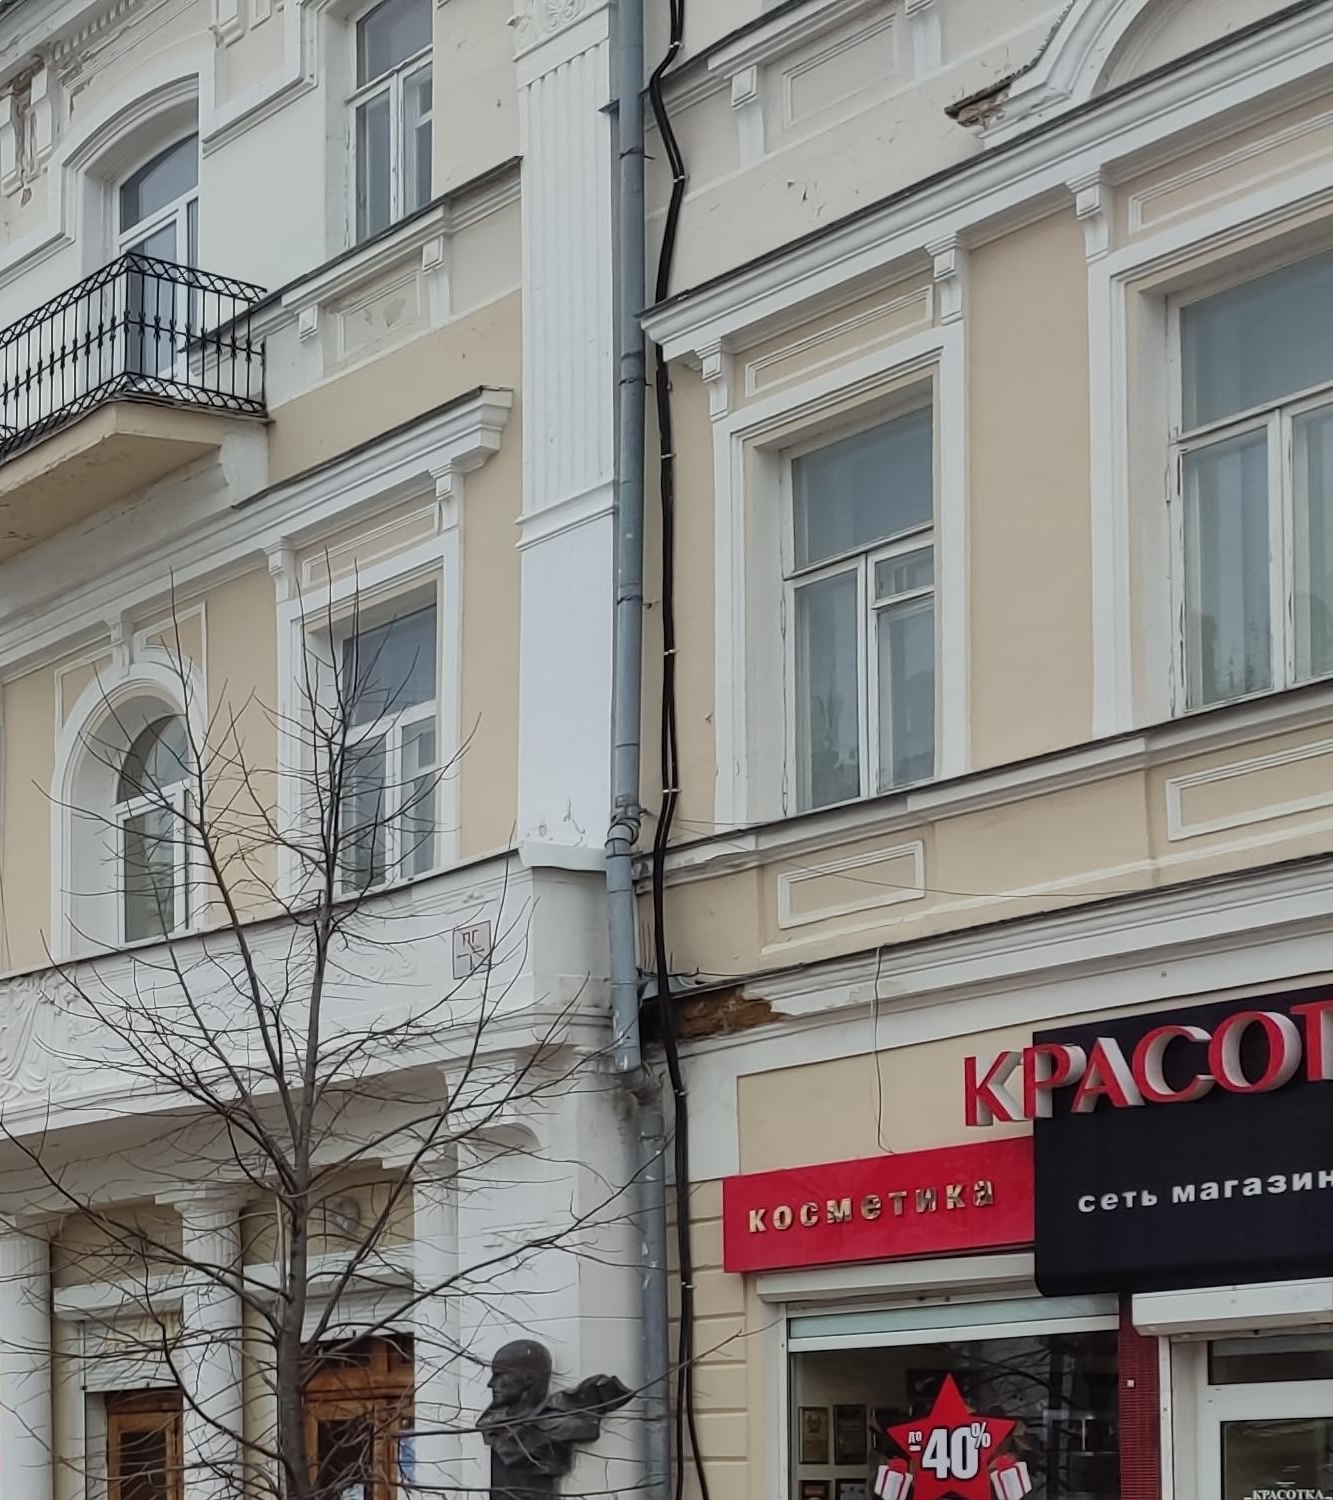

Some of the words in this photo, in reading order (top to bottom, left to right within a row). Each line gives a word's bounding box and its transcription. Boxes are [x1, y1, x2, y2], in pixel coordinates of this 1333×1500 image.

[748, 1180, 994, 1233] косметика
[1078, 1190, 1158, 1213] сеть
[1252, 1489, 1324, 1500] КРАСОТКА
